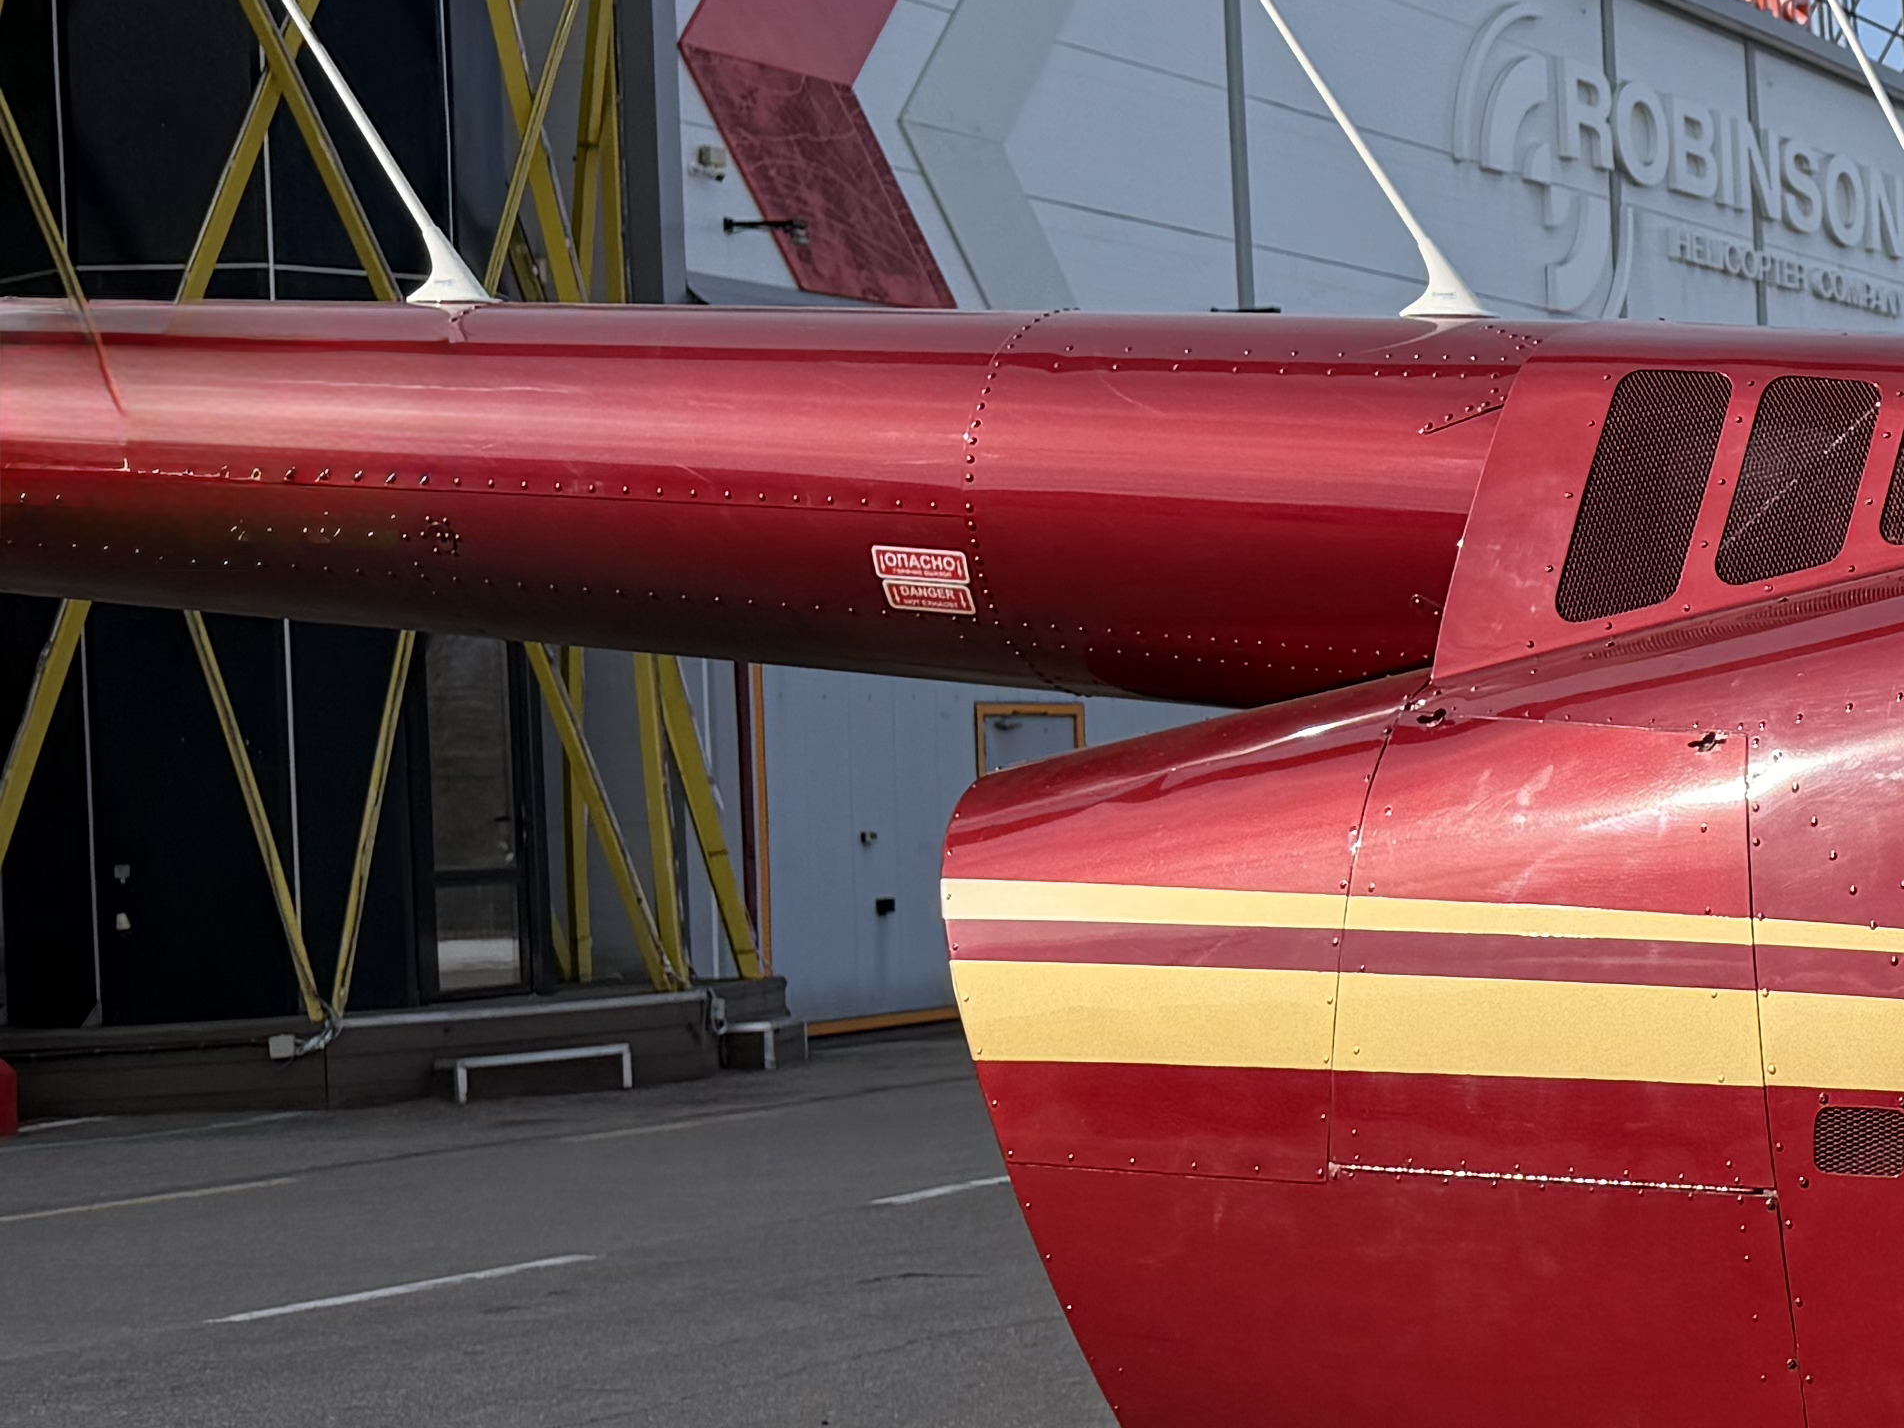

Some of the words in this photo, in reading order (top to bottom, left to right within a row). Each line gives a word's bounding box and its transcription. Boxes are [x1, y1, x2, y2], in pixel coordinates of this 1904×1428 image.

[1668, 228, 1809, 292] HELICOPTER
[1811, 264, 1904, 319] COMPANY
[884, 551, 956, 571] ОПАСНО
[899, 585, 956, 600] DANGER
